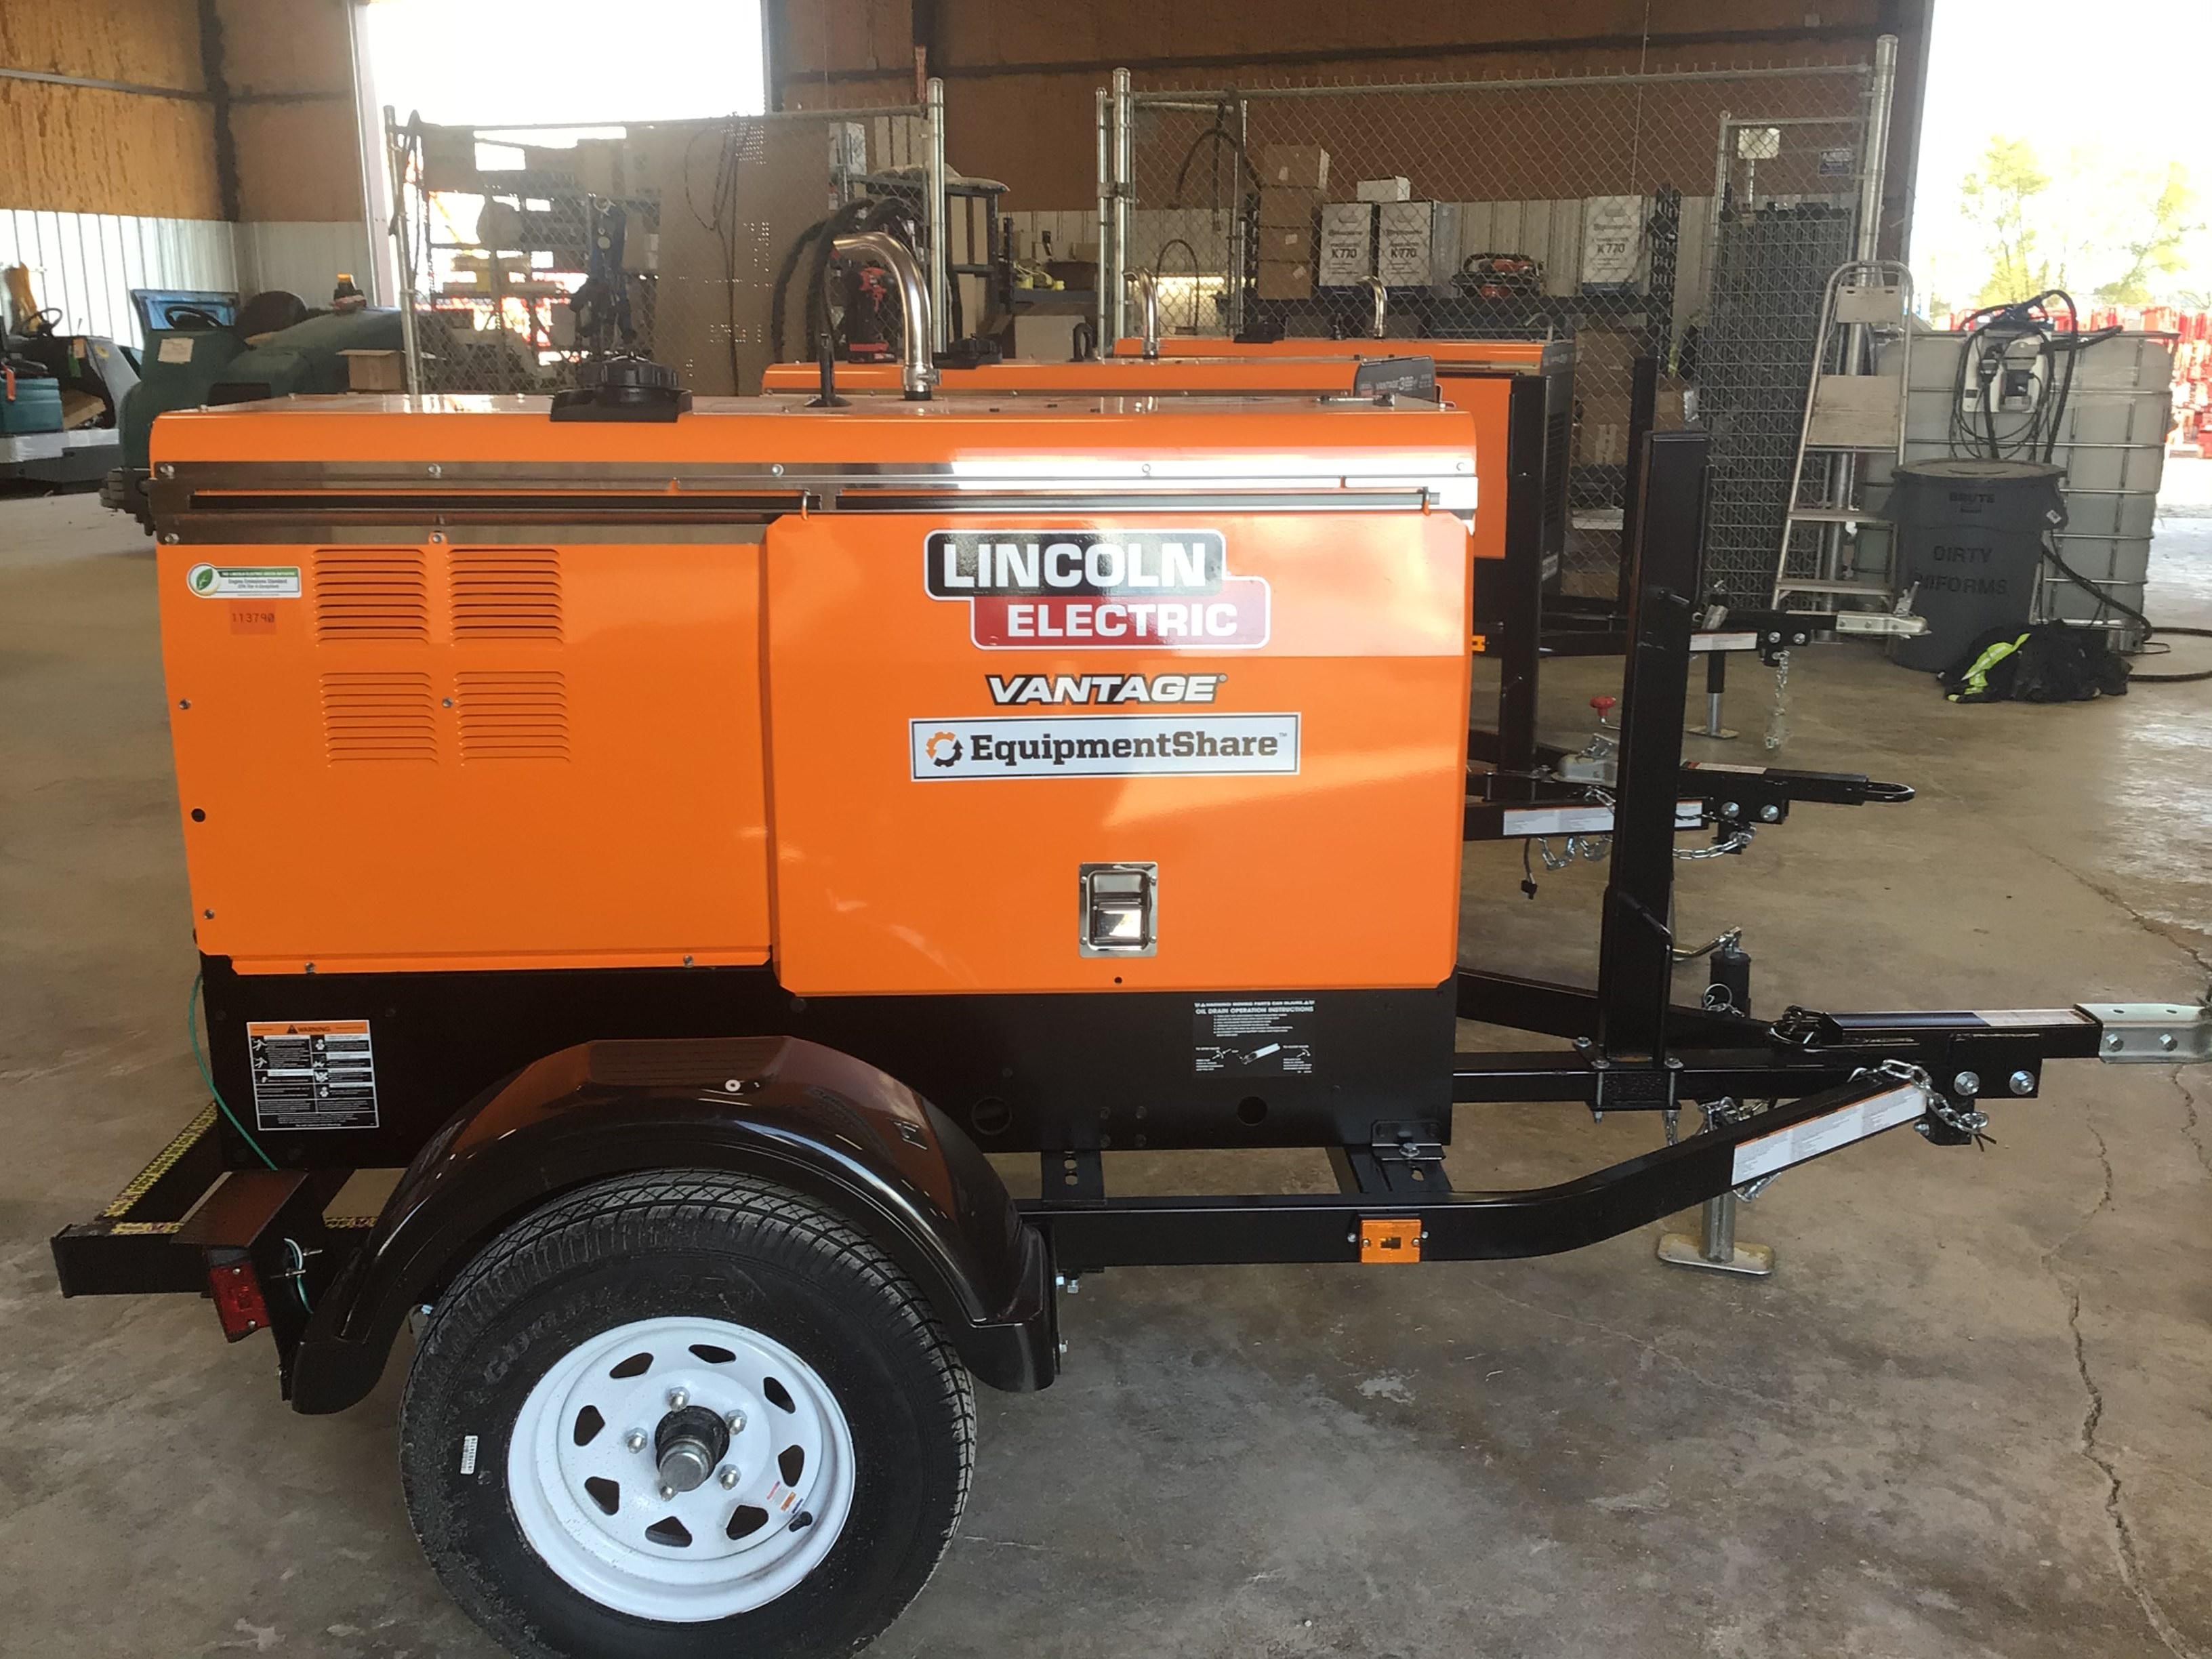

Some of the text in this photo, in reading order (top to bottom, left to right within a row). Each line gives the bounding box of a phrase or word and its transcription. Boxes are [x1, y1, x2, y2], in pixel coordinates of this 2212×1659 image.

[1950, 492, 1995, 504] BRUTE
[943, 542, 1206, 588] LINCOLN
[1933, 546, 1993, 563] DIRTY
[1007, 603, 1237, 637] ELECTRIC
[987, 674, 1218, 703] VANTAGE
[970, 731, 1278, 767] EquipmentShare
